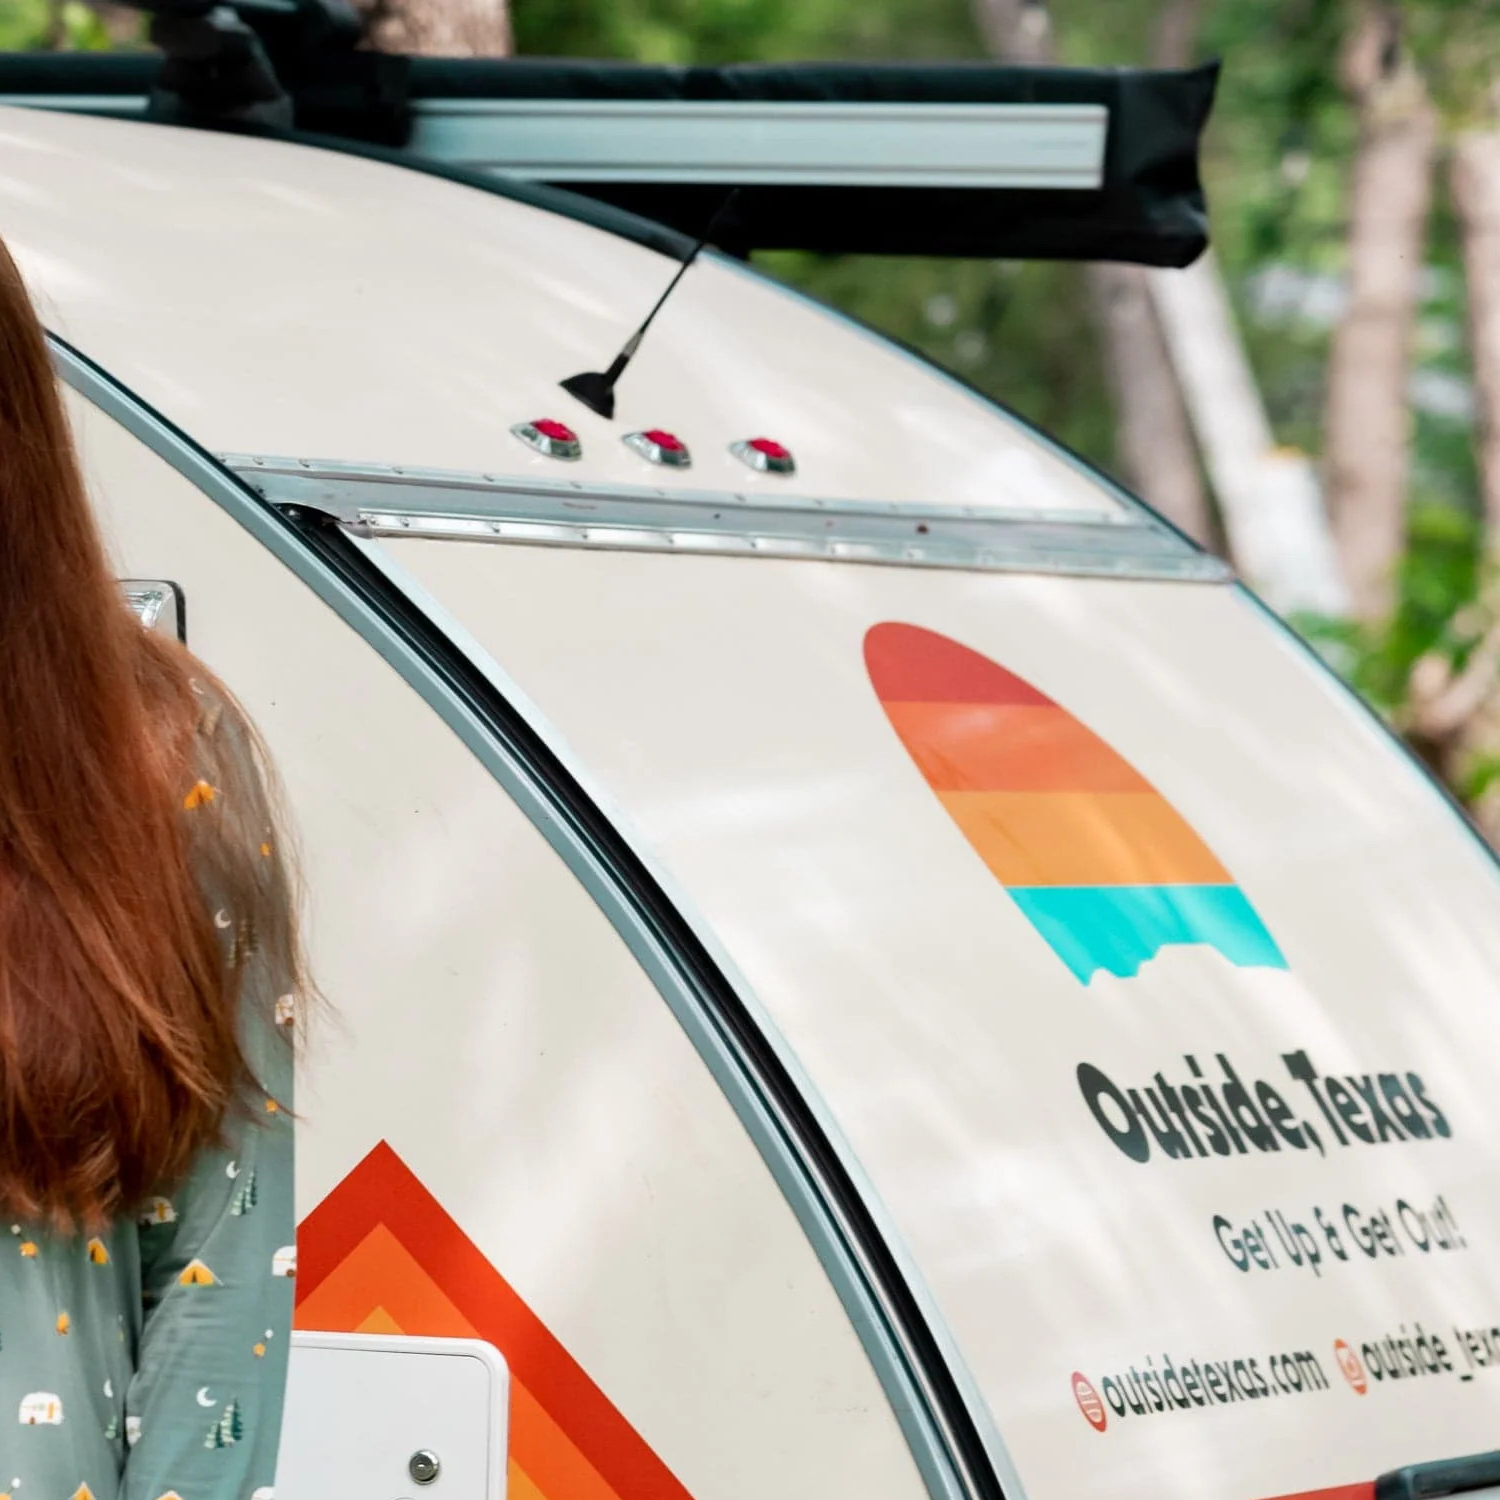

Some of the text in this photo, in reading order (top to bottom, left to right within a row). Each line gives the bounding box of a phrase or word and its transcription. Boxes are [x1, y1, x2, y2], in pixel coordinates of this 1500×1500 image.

[1077, 1049, 1452, 1163] Outside, Texas
[1213, 1195, 1467, 1277] Get Up & Get Out!
[1102, 1351, 1330, 1417] outsidetexas.com
